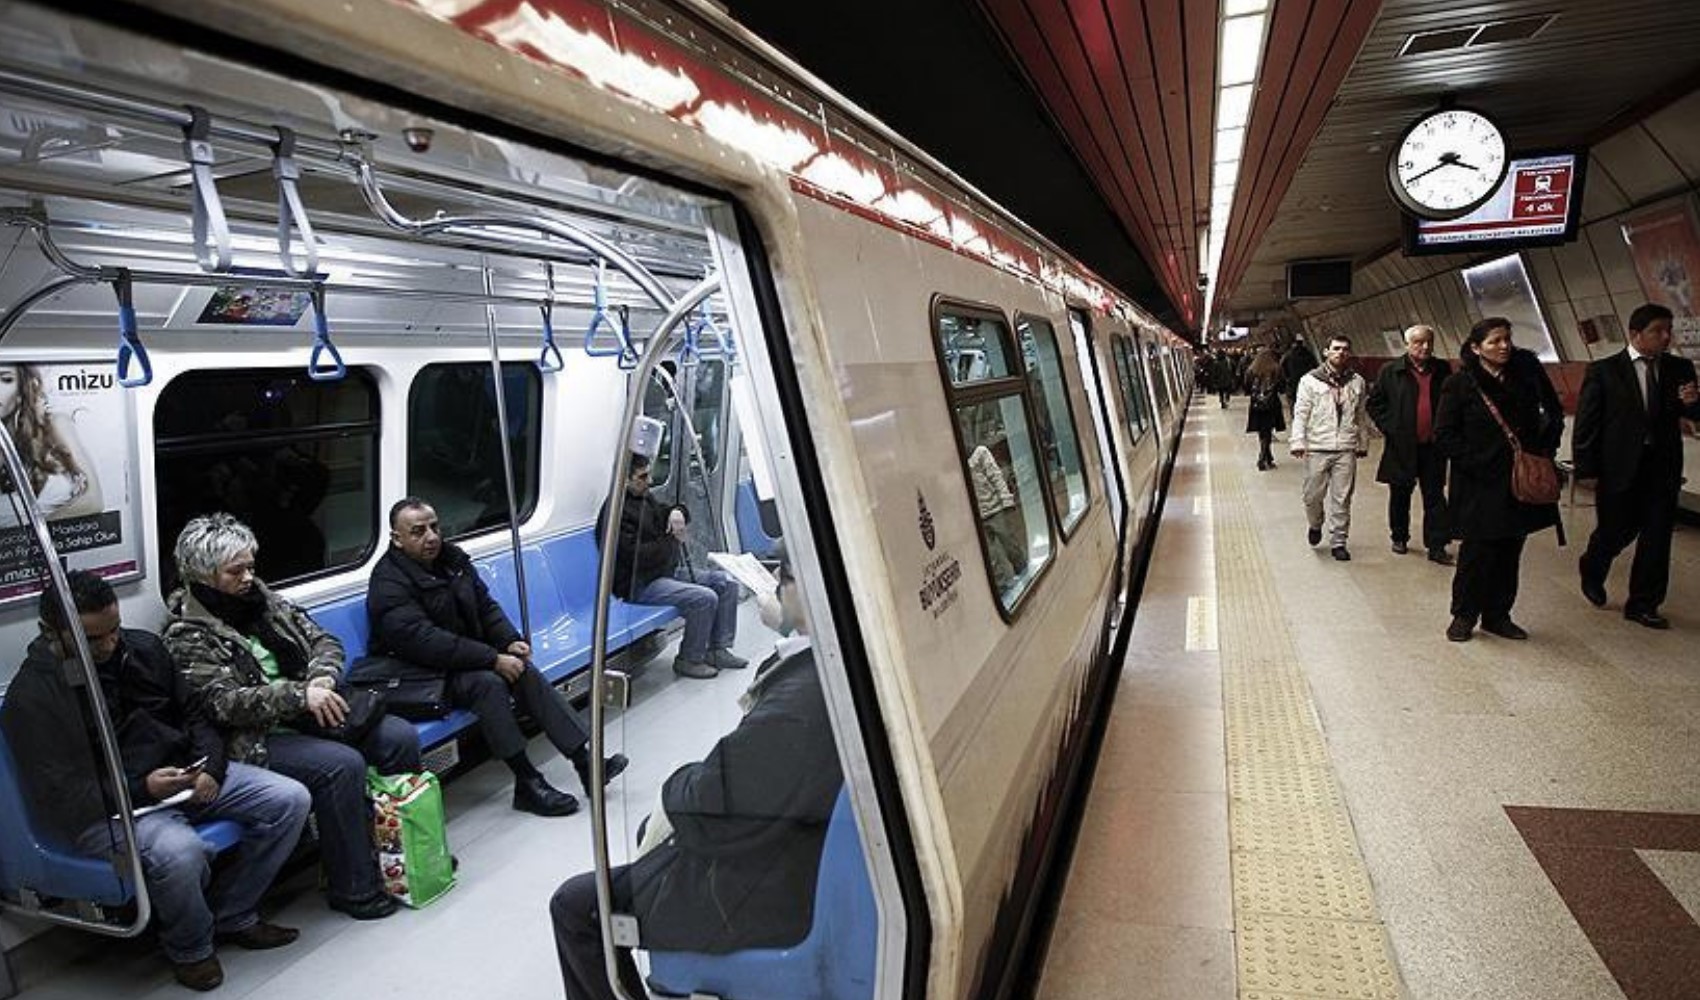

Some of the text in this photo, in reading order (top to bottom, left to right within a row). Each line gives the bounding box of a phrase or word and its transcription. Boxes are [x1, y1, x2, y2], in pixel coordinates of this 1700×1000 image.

[1405, 161, 1414, 170] 9
[1525, 203, 1535, 212] 4
[58, 369, 113, 390] mizu
